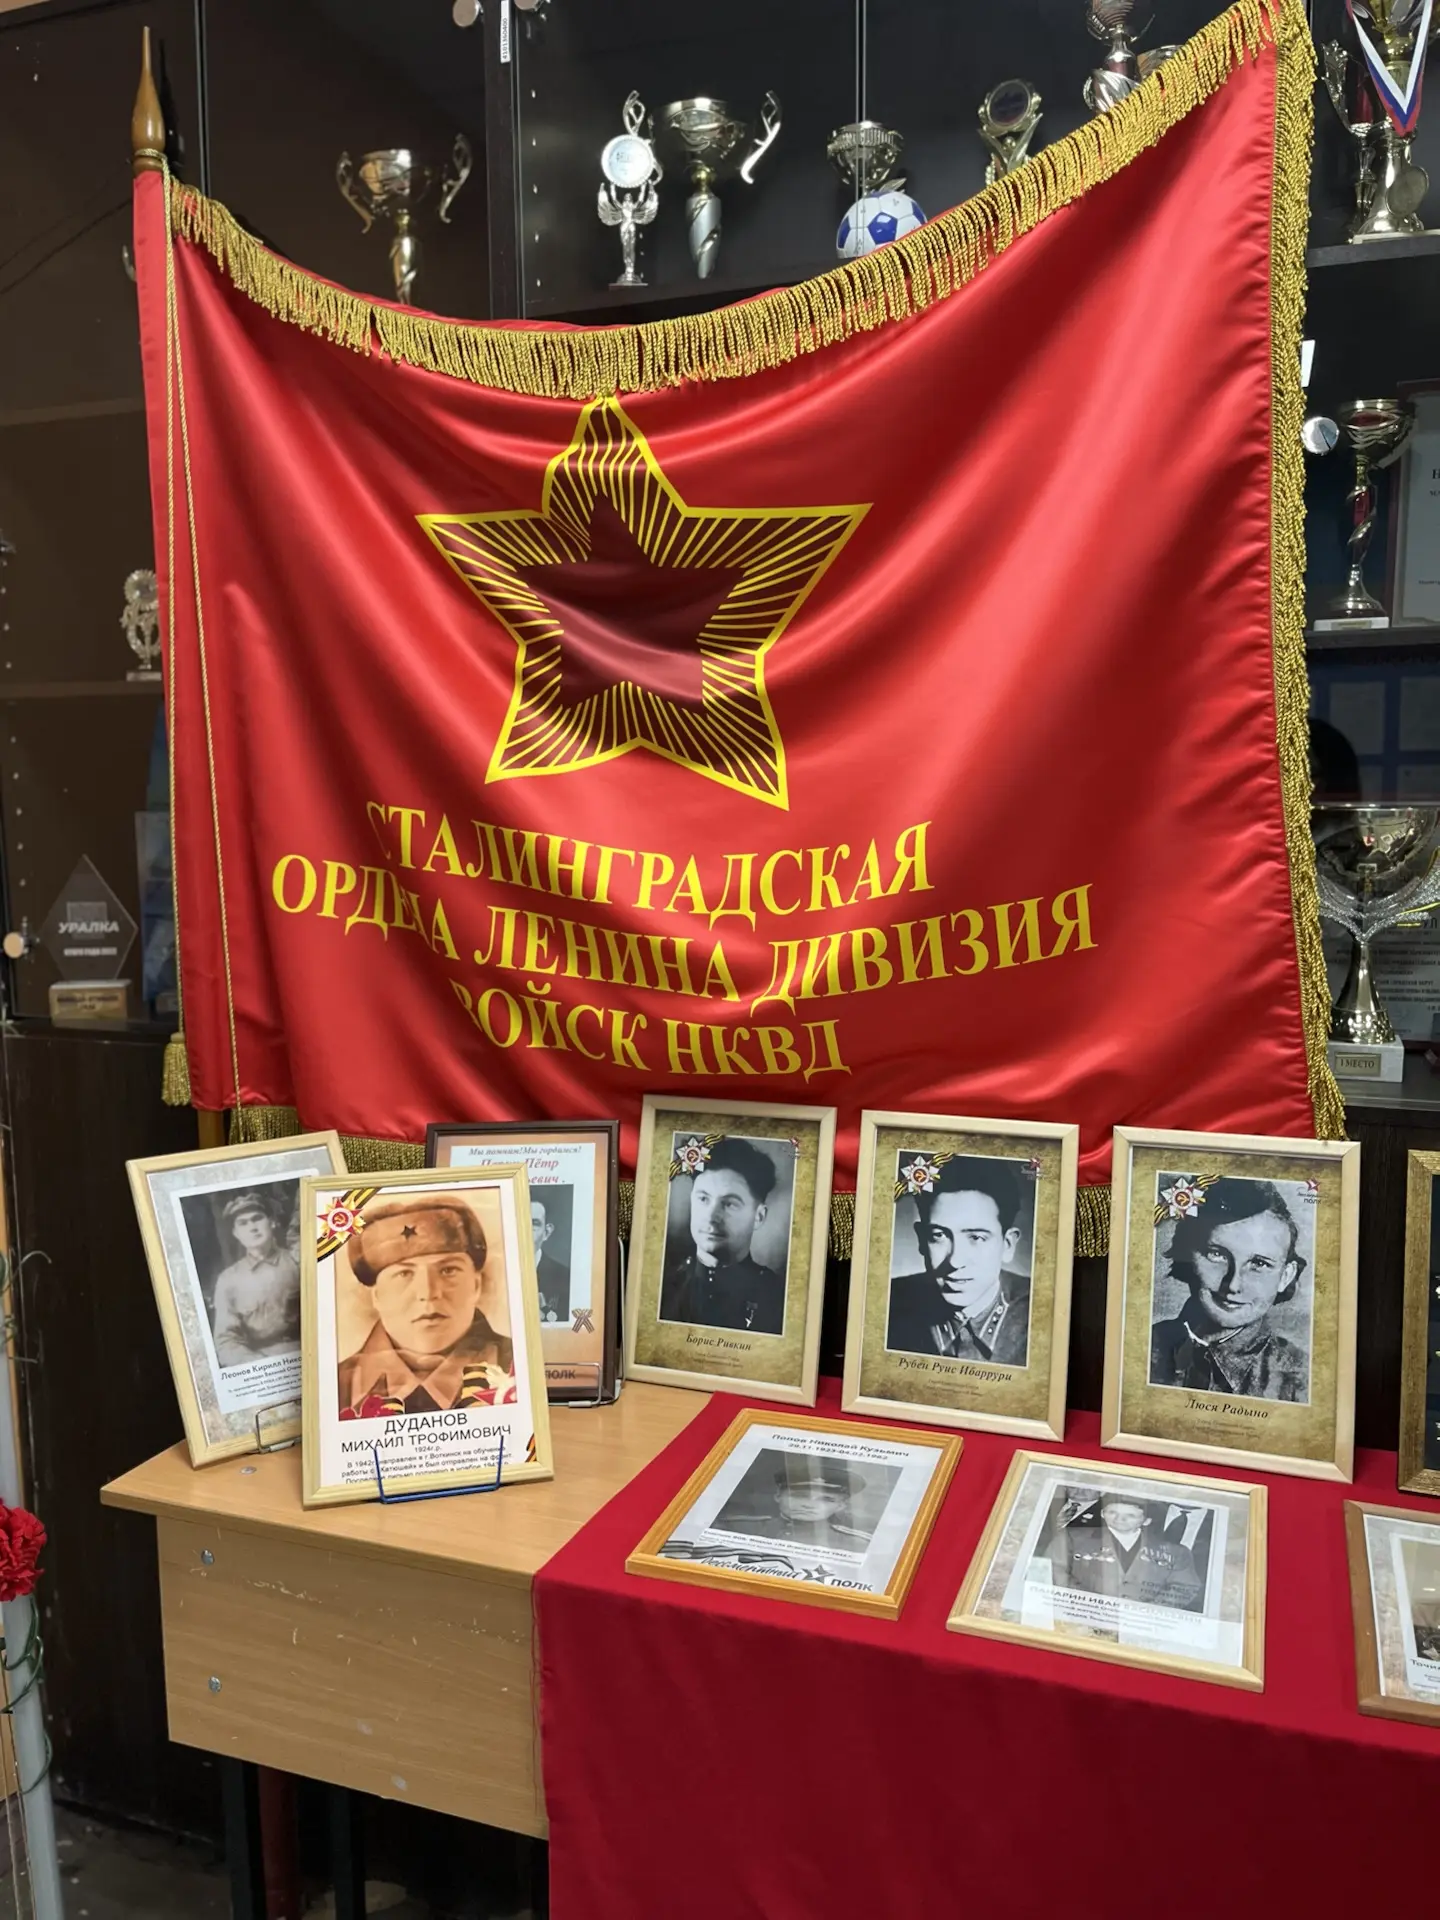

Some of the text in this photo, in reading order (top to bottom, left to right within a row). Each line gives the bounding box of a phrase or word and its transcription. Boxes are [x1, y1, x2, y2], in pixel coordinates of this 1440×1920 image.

[58, 921, 119, 934] УРАЛКА
[474, 905, 741, 1003] ЛЕНИНА
[750, 884, 1099, 1017] ДИВИЗИЯ
[663, 1018, 851, 1083] НКВД
[1347, 1058, 1375, 1069] МЕСТО
[523, 1157, 560, 1171] Пётр
[686, 1332, 752, 1351] Борис Ривкин
[221, 1369, 251, 1380] Леонов
[252, 1361, 282, 1373] Кирилл
[898, 1357, 1013, 1382] Рубен Руис Ибаррури
[1185, 1398, 1269, 1419] Люся Радыно
[385, 1412, 468, 1435] ДУДАНОВ
[342, 1424, 512, 1453] МИХАИЛ ТРОФИМОВИЧ
[772, 1432, 909, 1457] Попов Николай Кузьмич
[341, 1469, 368, 1479] работы
[441, 1457, 478, 1467] отправлен
[830, 1578, 873, 1592] ПОЛК
[1089, 1596, 1120, 1608] ИВАН
